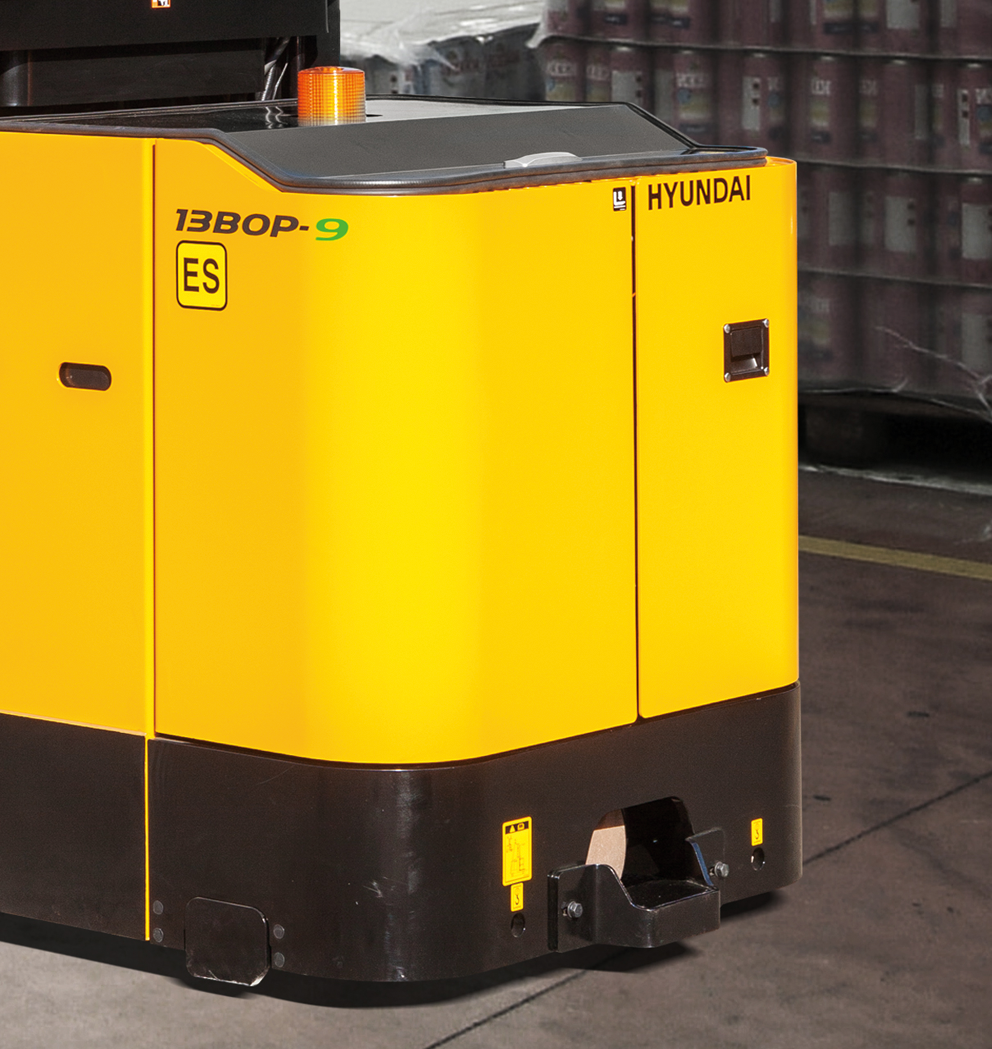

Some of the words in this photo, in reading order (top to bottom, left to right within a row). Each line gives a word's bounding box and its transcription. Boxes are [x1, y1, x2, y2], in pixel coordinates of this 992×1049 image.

[648, 175, 751, 210] HYUNDAI
[175, 208, 349, 242] 13BOP-9
[182, 257, 220, 294] ES
